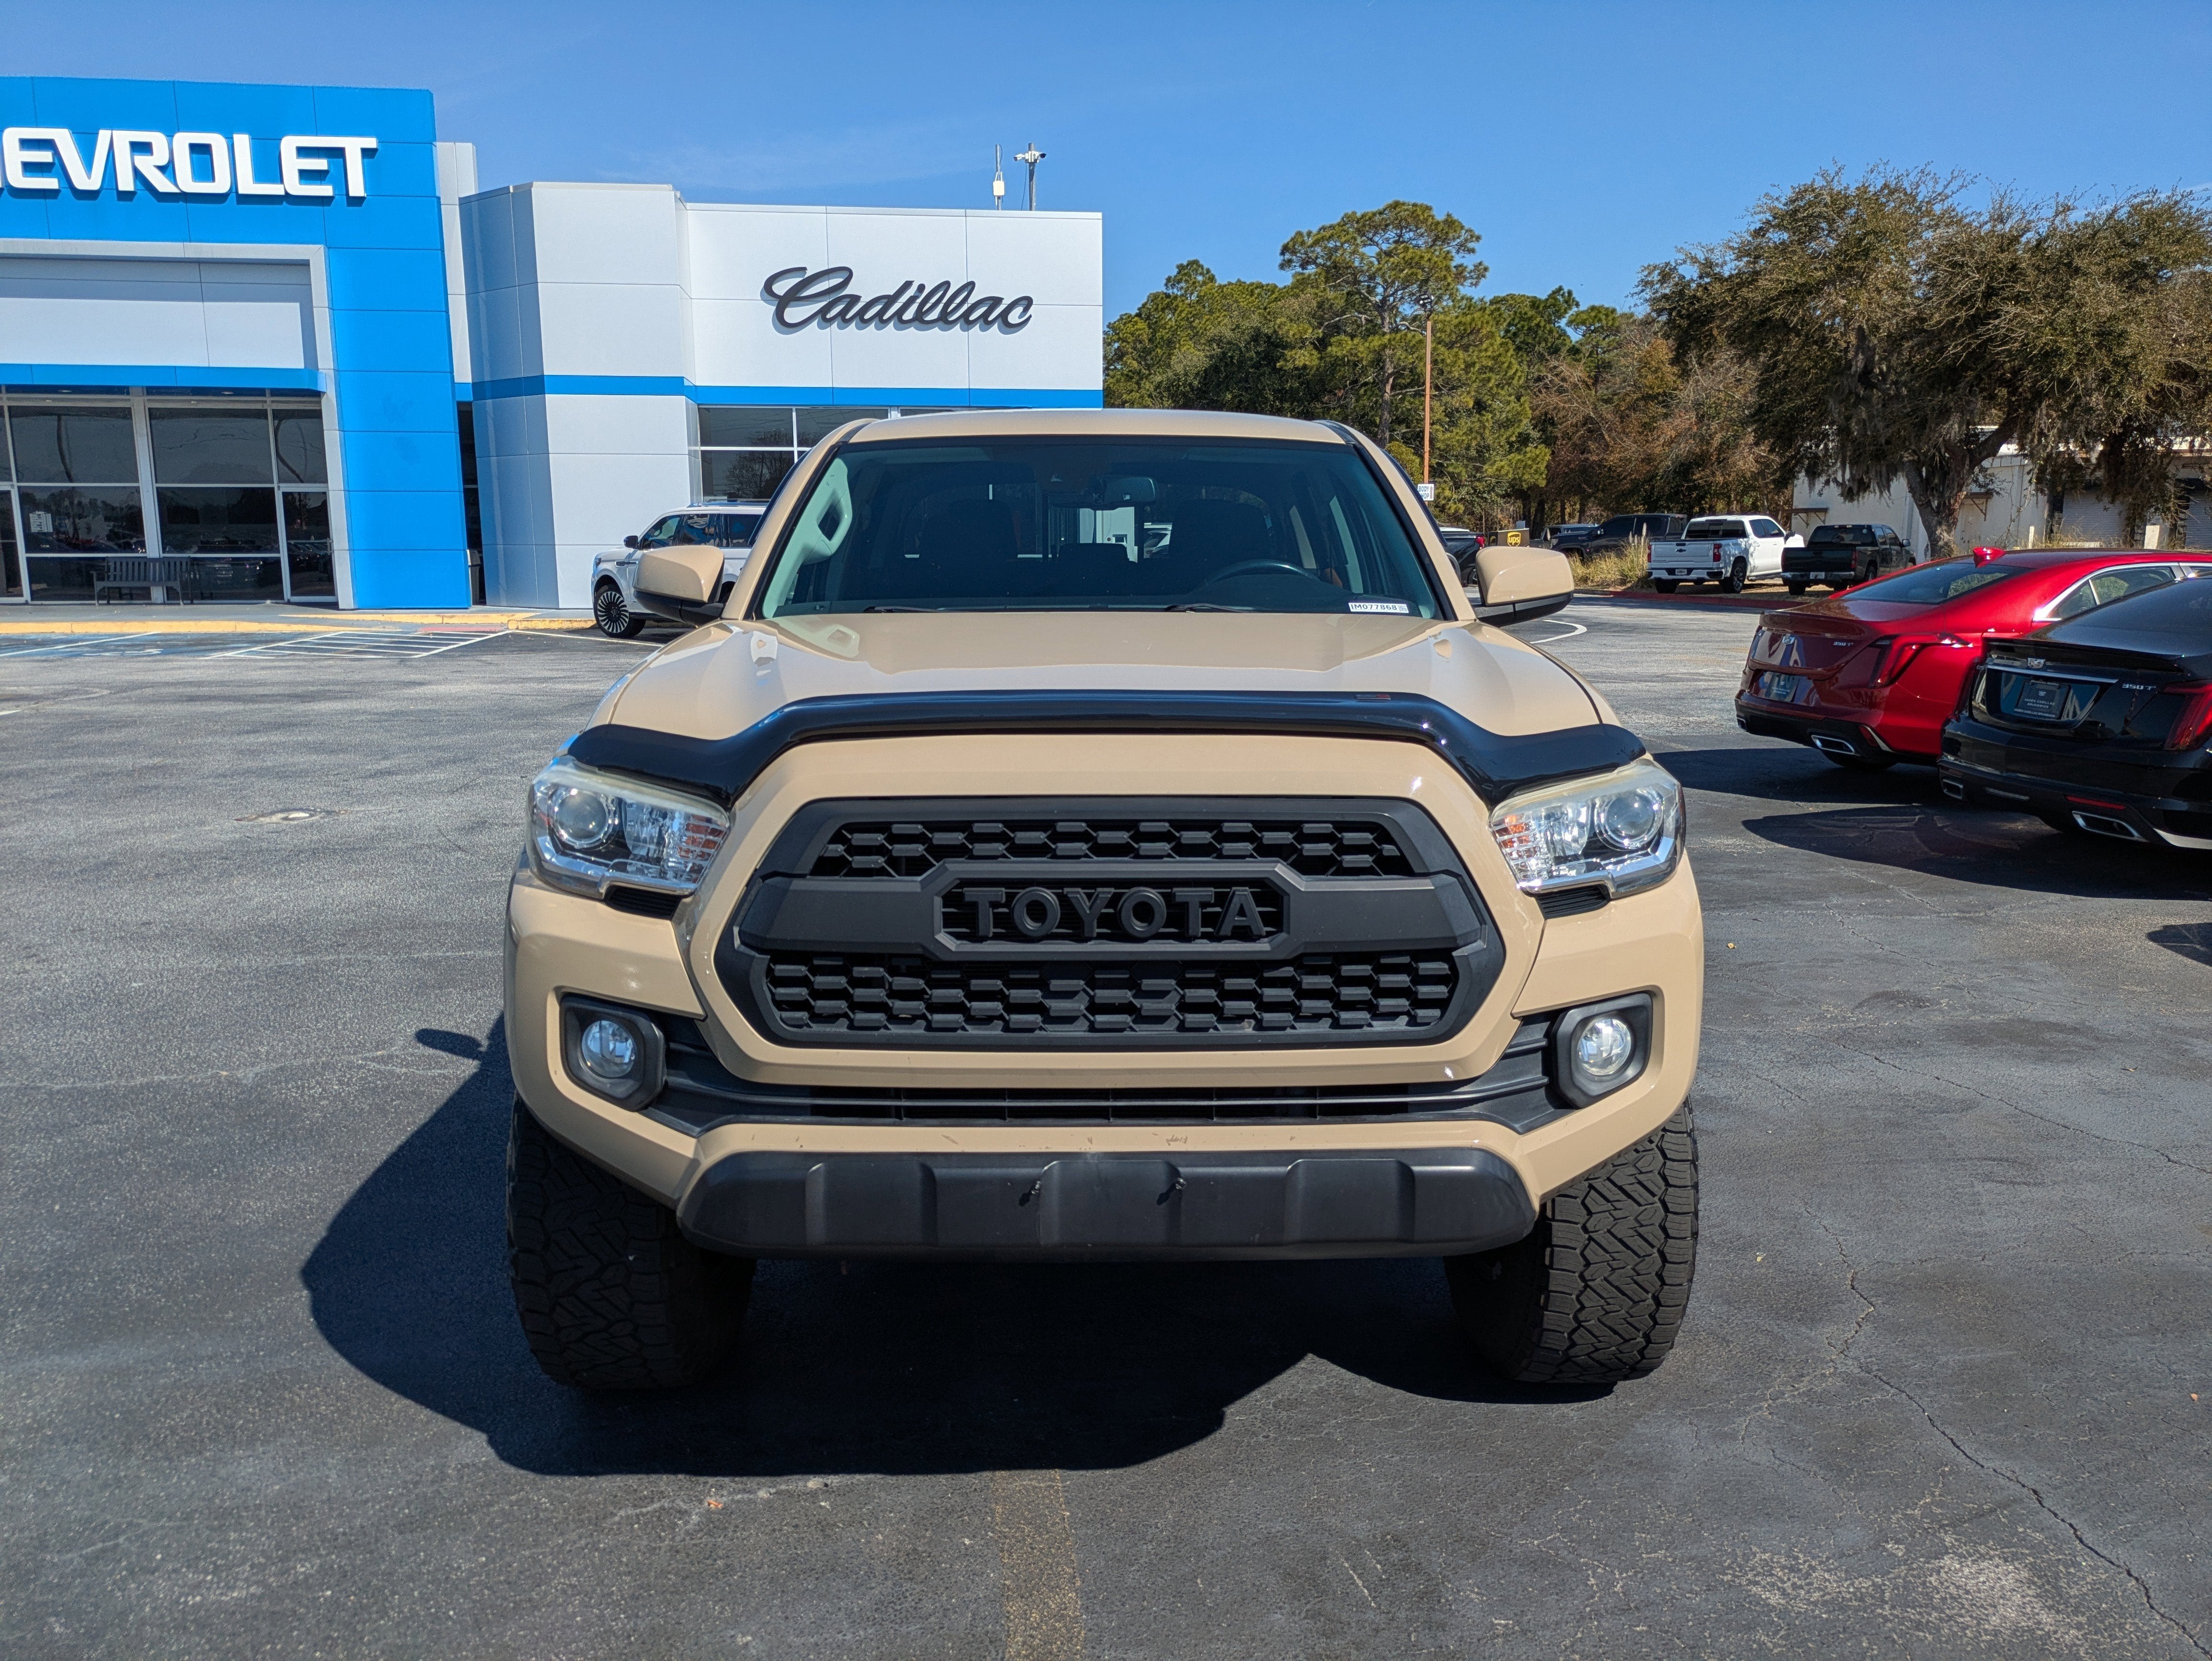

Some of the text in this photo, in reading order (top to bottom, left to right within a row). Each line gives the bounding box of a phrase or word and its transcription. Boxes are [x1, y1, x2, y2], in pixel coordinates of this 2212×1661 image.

[0, 127, 377, 198] EVROLET
[763, 266, 1033, 329] Cadillac
[1508, 536, 1520, 545] ups
[963, 886, 1267, 938] TOYOTA
